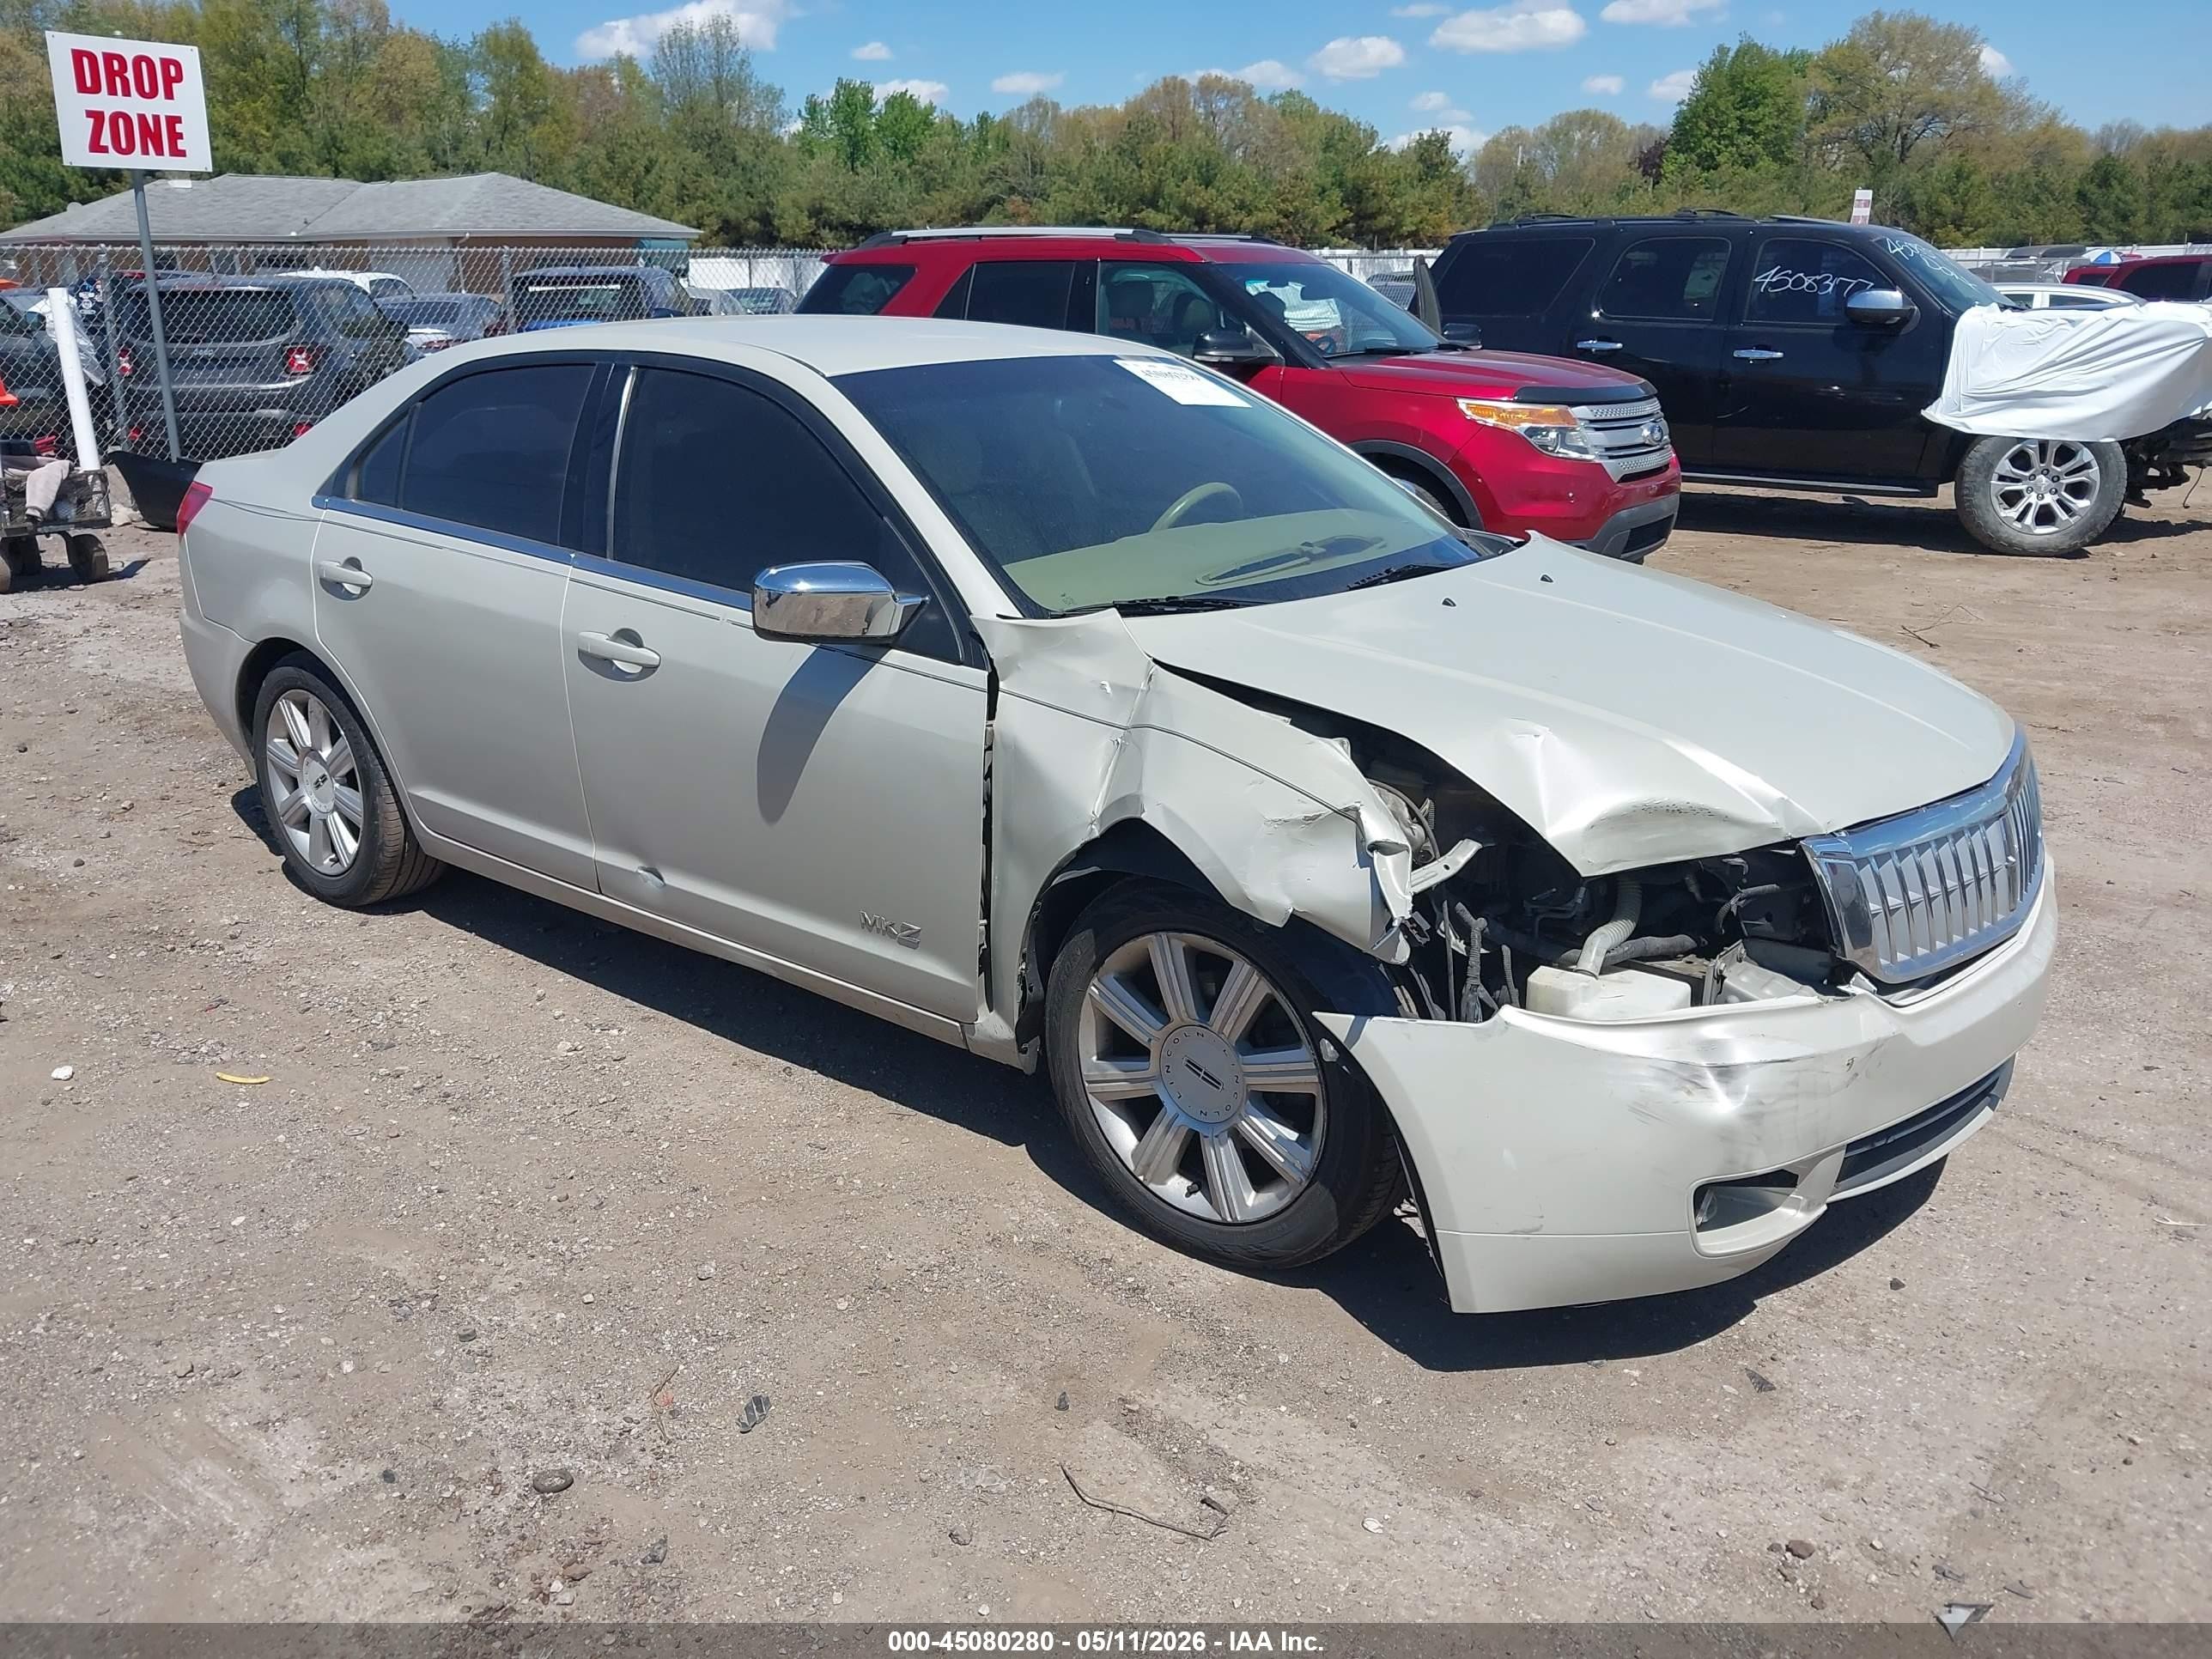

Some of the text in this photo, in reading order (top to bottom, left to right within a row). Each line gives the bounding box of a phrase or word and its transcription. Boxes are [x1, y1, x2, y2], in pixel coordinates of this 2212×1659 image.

[71, 48, 184, 100] DROP
[86, 110, 186, 157] ZONE
[859, 910, 921, 950] MKZ
